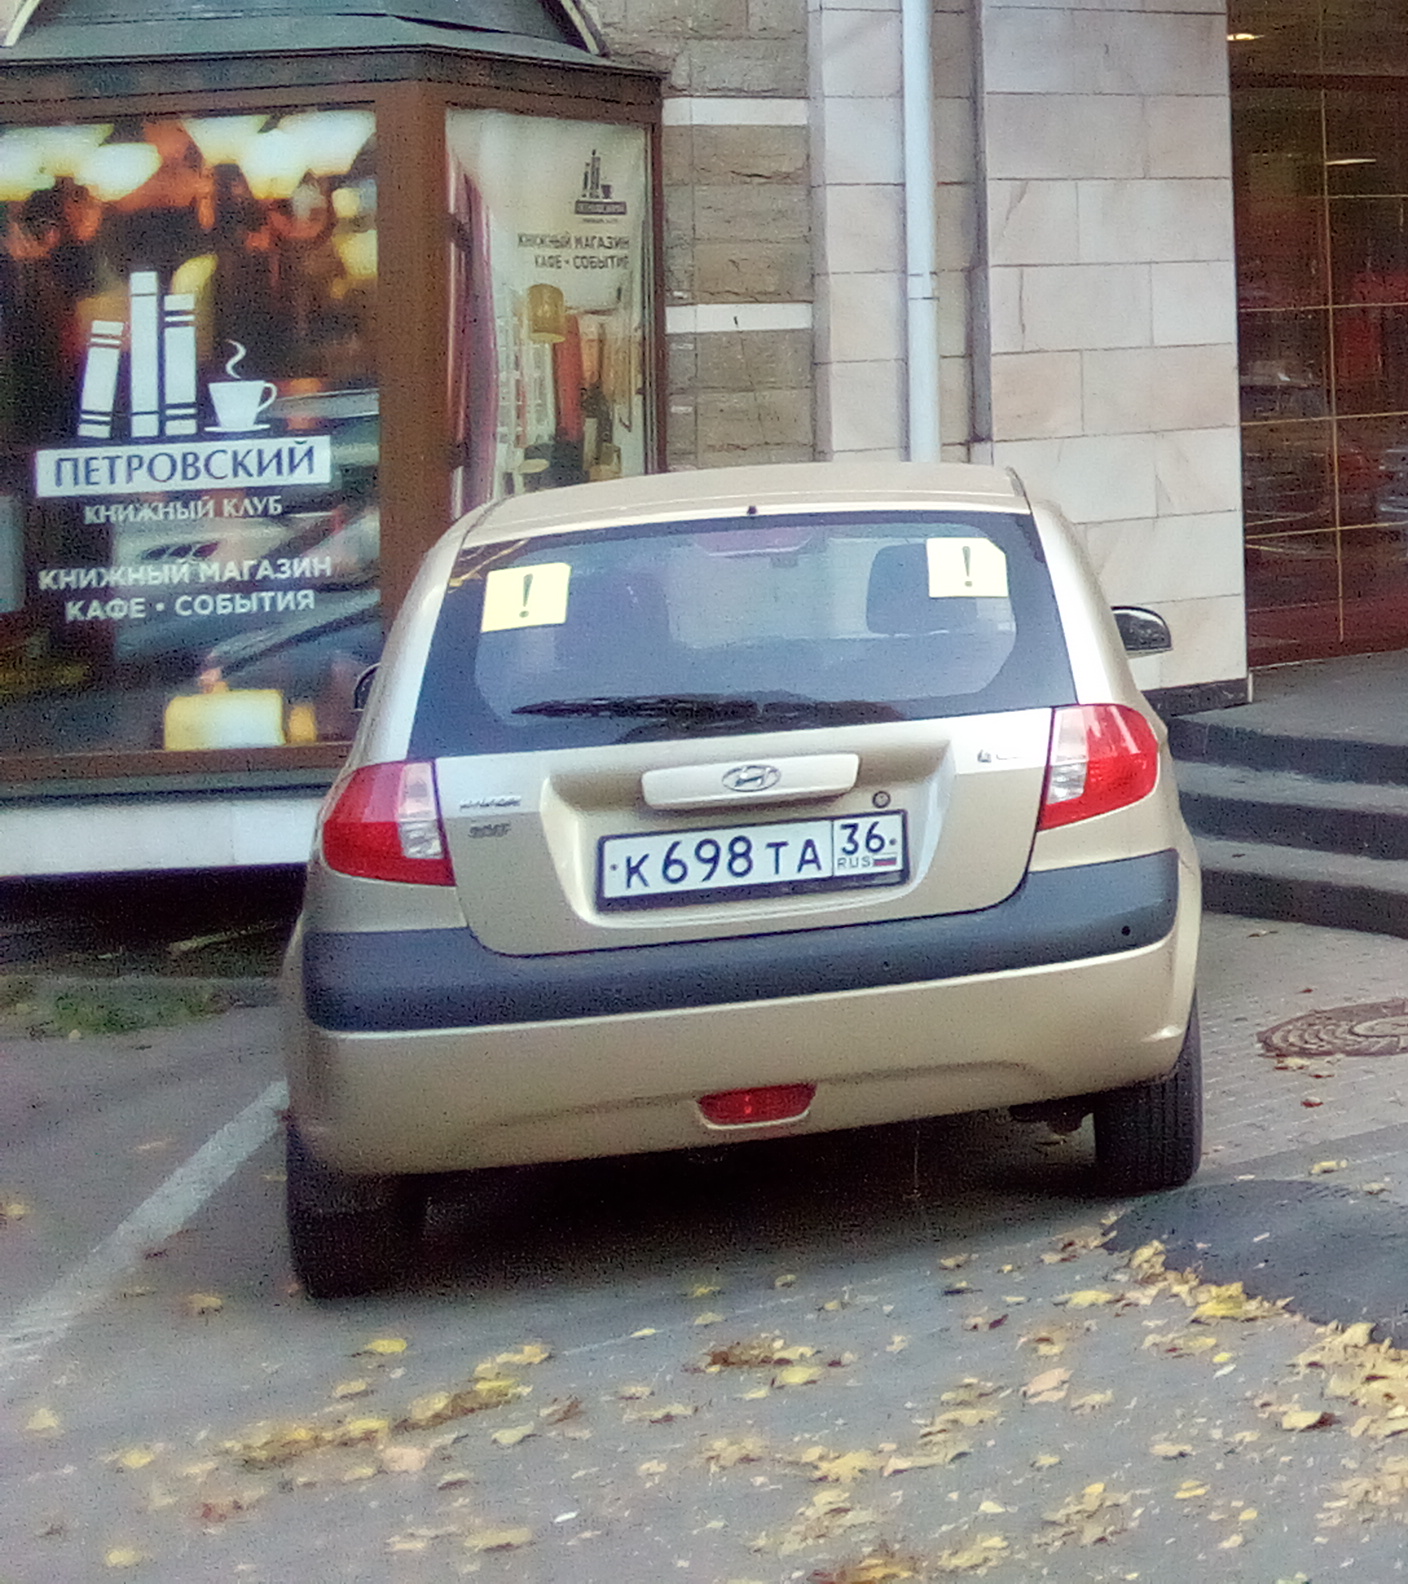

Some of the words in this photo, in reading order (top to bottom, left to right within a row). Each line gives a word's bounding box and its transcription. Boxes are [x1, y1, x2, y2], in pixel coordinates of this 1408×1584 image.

[54, 438, 315, 488] ПЕТРОВСКИЙ
[84, 497, 215, 525] КНИЖНЫЙ
[223, 495, 283, 517] КЛУБ
[39, 559, 189, 590] КНИЖНЫЙ
[199, 556, 332, 584] МАГАЗИН
[65, 597, 146, 621] КАФЕ
[175, 589, 316, 616] СОБЫТИЯ
[840, 821, 886, 856] 36
[837, 857, 871, 869] RUS
